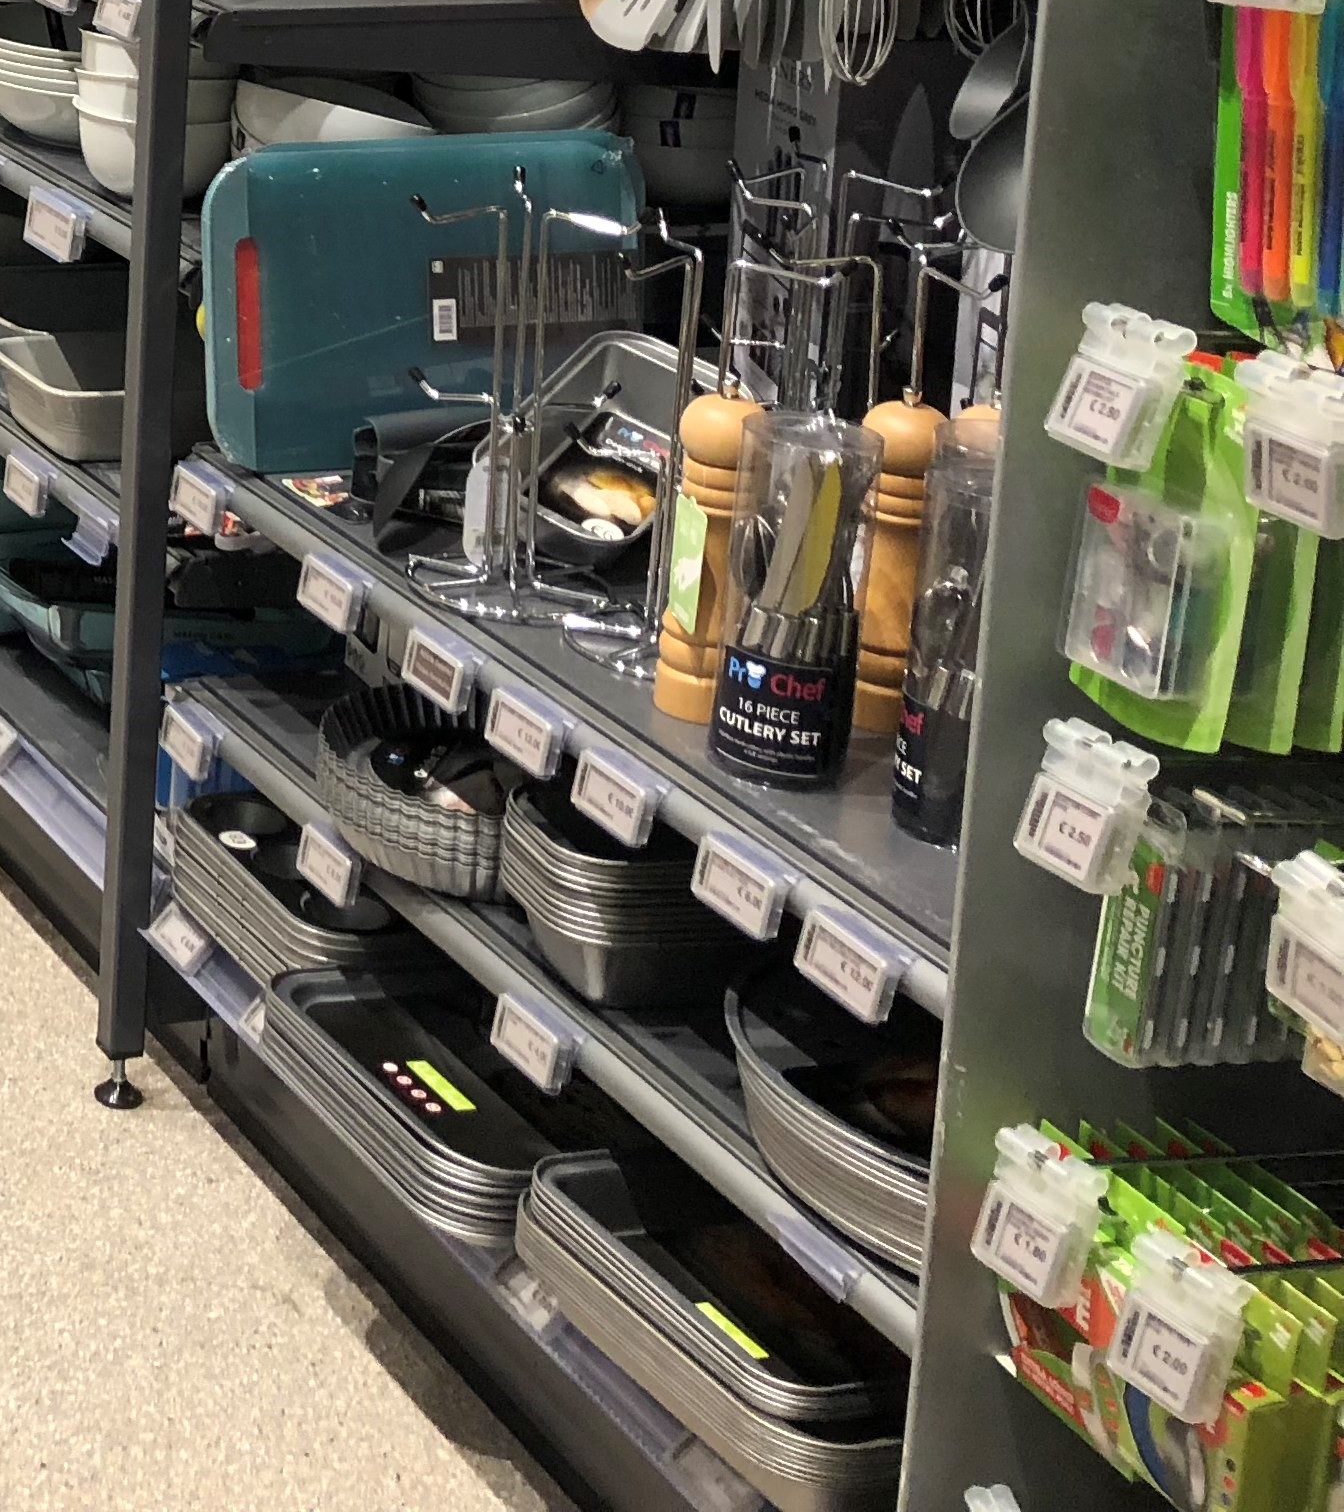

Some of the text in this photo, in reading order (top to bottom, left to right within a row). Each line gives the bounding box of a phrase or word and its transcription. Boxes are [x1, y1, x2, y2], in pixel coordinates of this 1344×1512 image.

[770, 673, 827, 702] Chef
[738, 697, 800, 725] 16 PIECE
[719, 706, 786, 742] CUTLERY
[790, 730, 821, 747] SET
[900, 762, 922, 785] SET
[1125, 903, 1150, 1001] PUNCTURE
[1112, 961, 1127, 992] KIT
